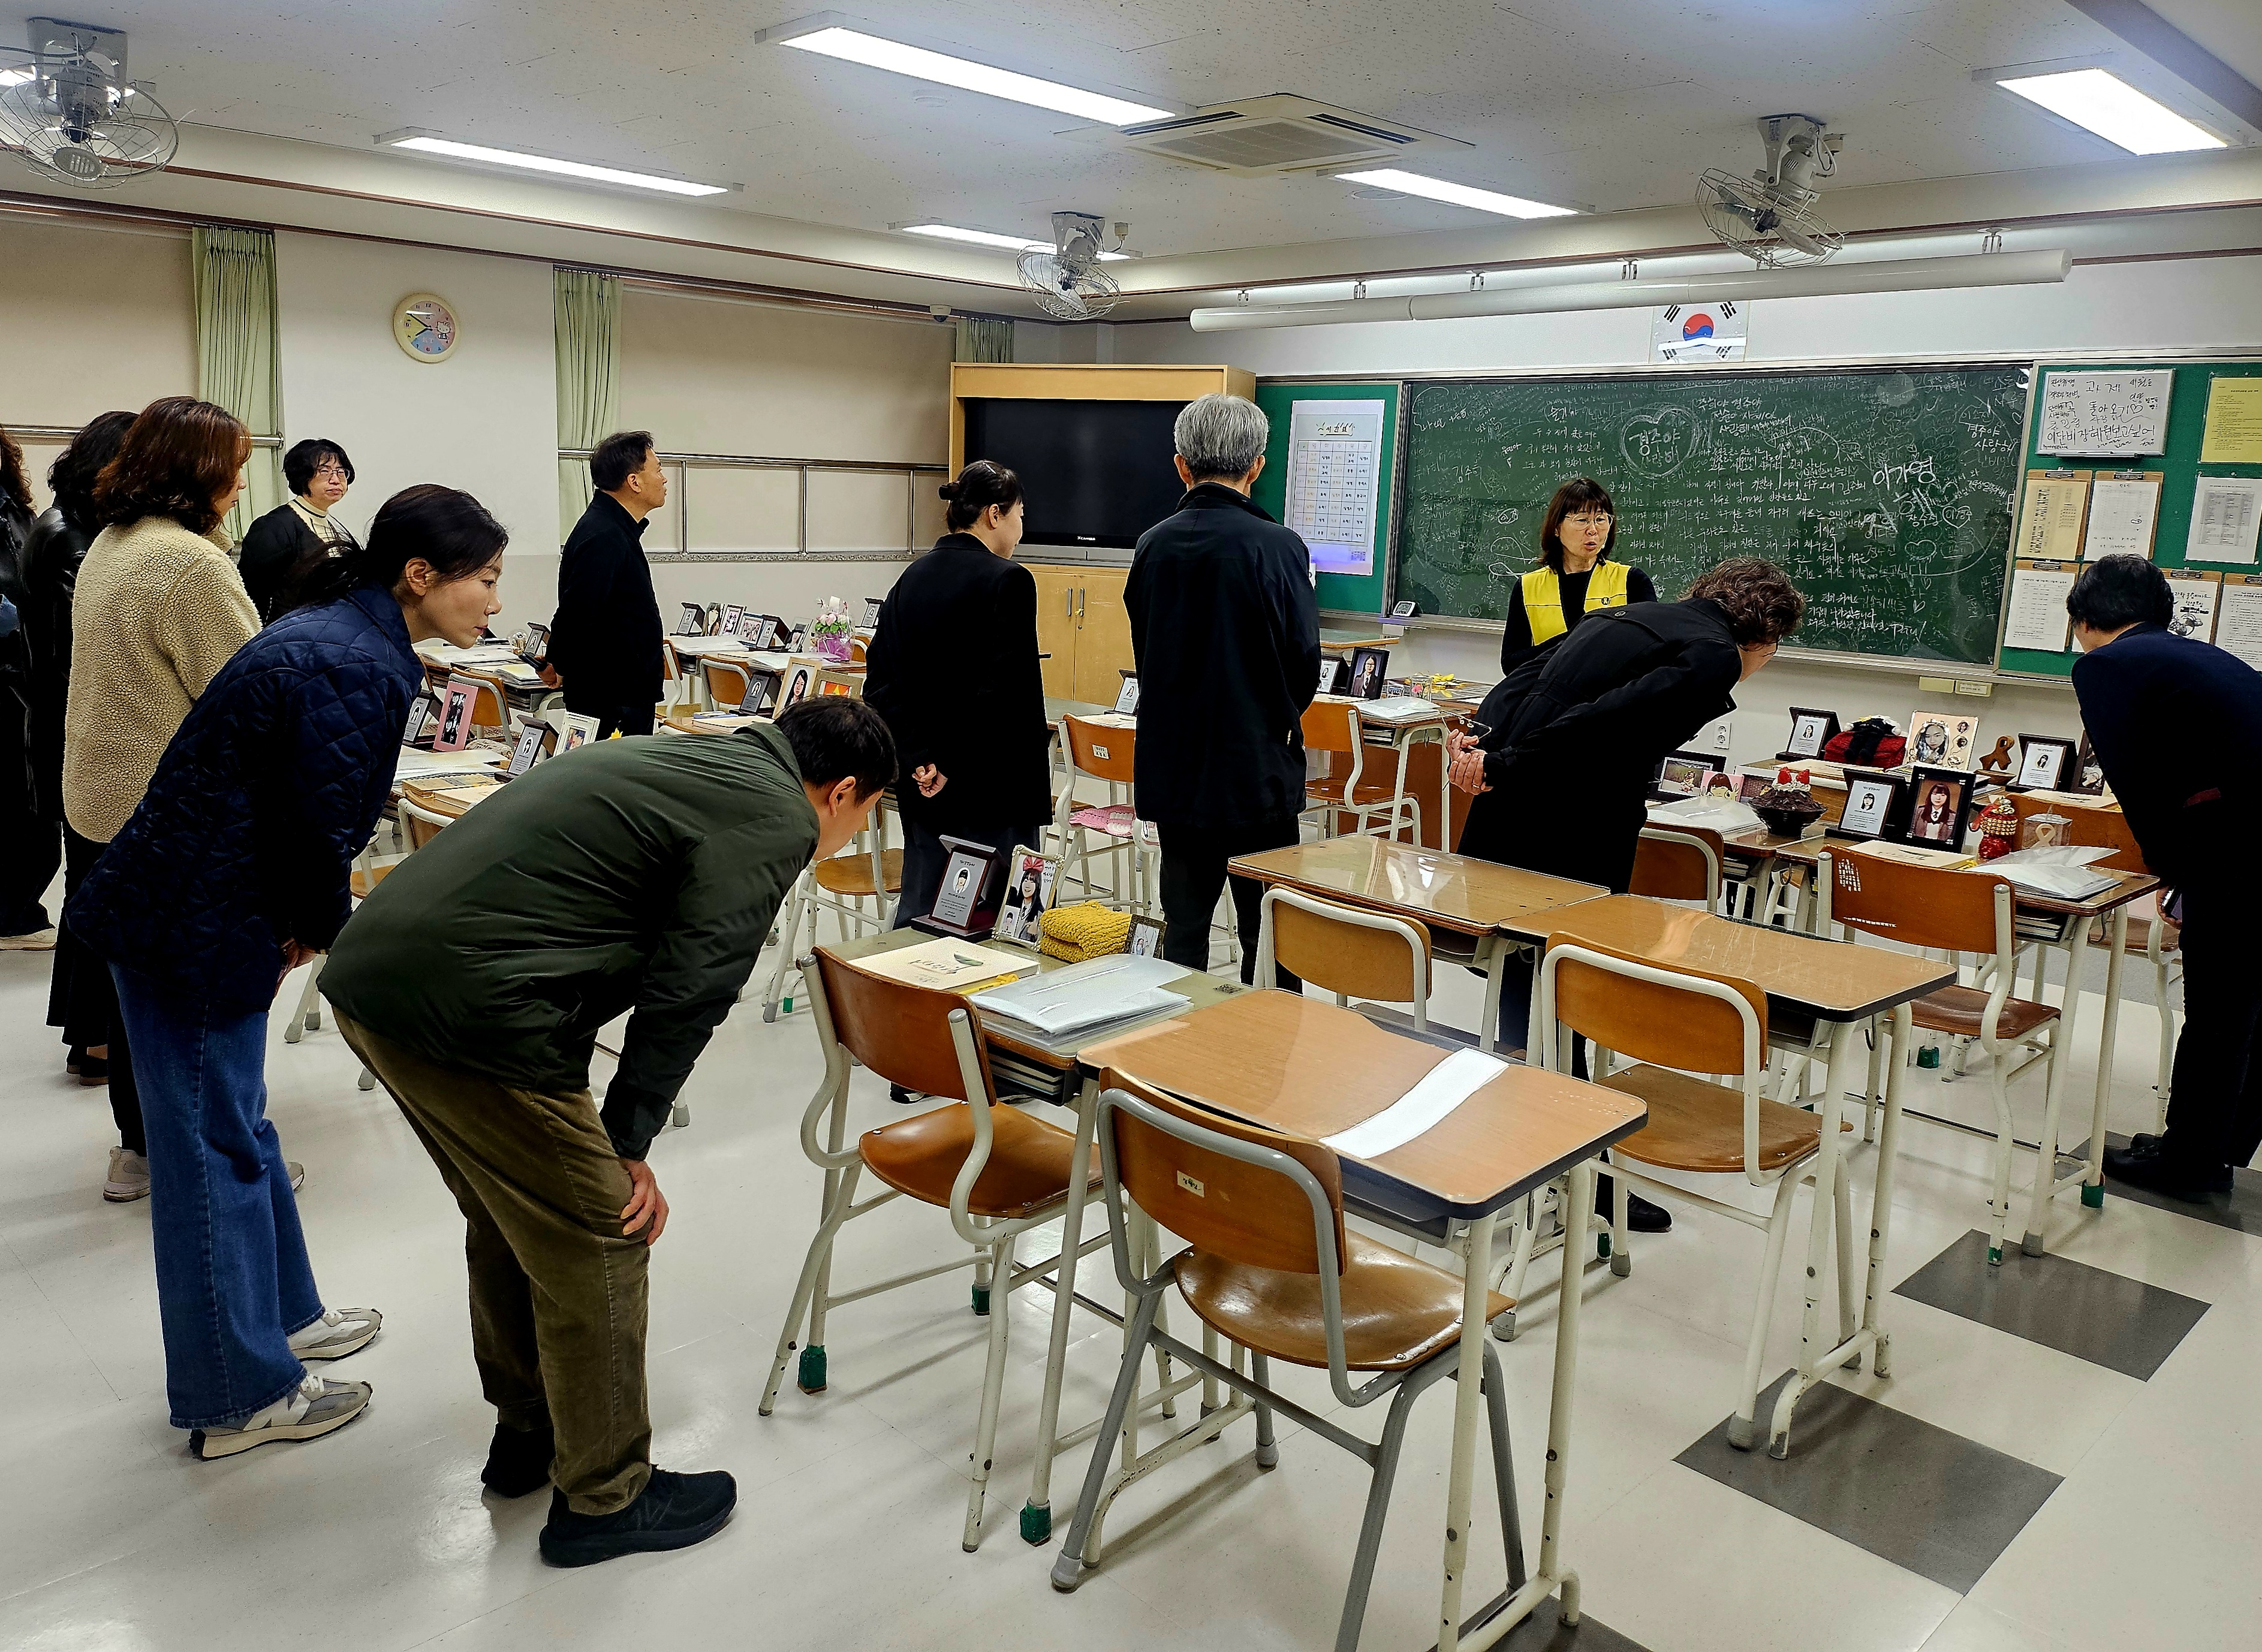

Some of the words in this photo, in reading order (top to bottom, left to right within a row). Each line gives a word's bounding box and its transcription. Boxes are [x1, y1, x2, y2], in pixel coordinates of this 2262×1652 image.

[1719, 423, 1749, 436] 사랑해
[1968, 424, 2001, 438] 경주야
[1628, 428, 1680, 456] 경주야
[1974, 438, 2014, 457] 사랑해
[1873, 456, 1936, 490] 이가영
